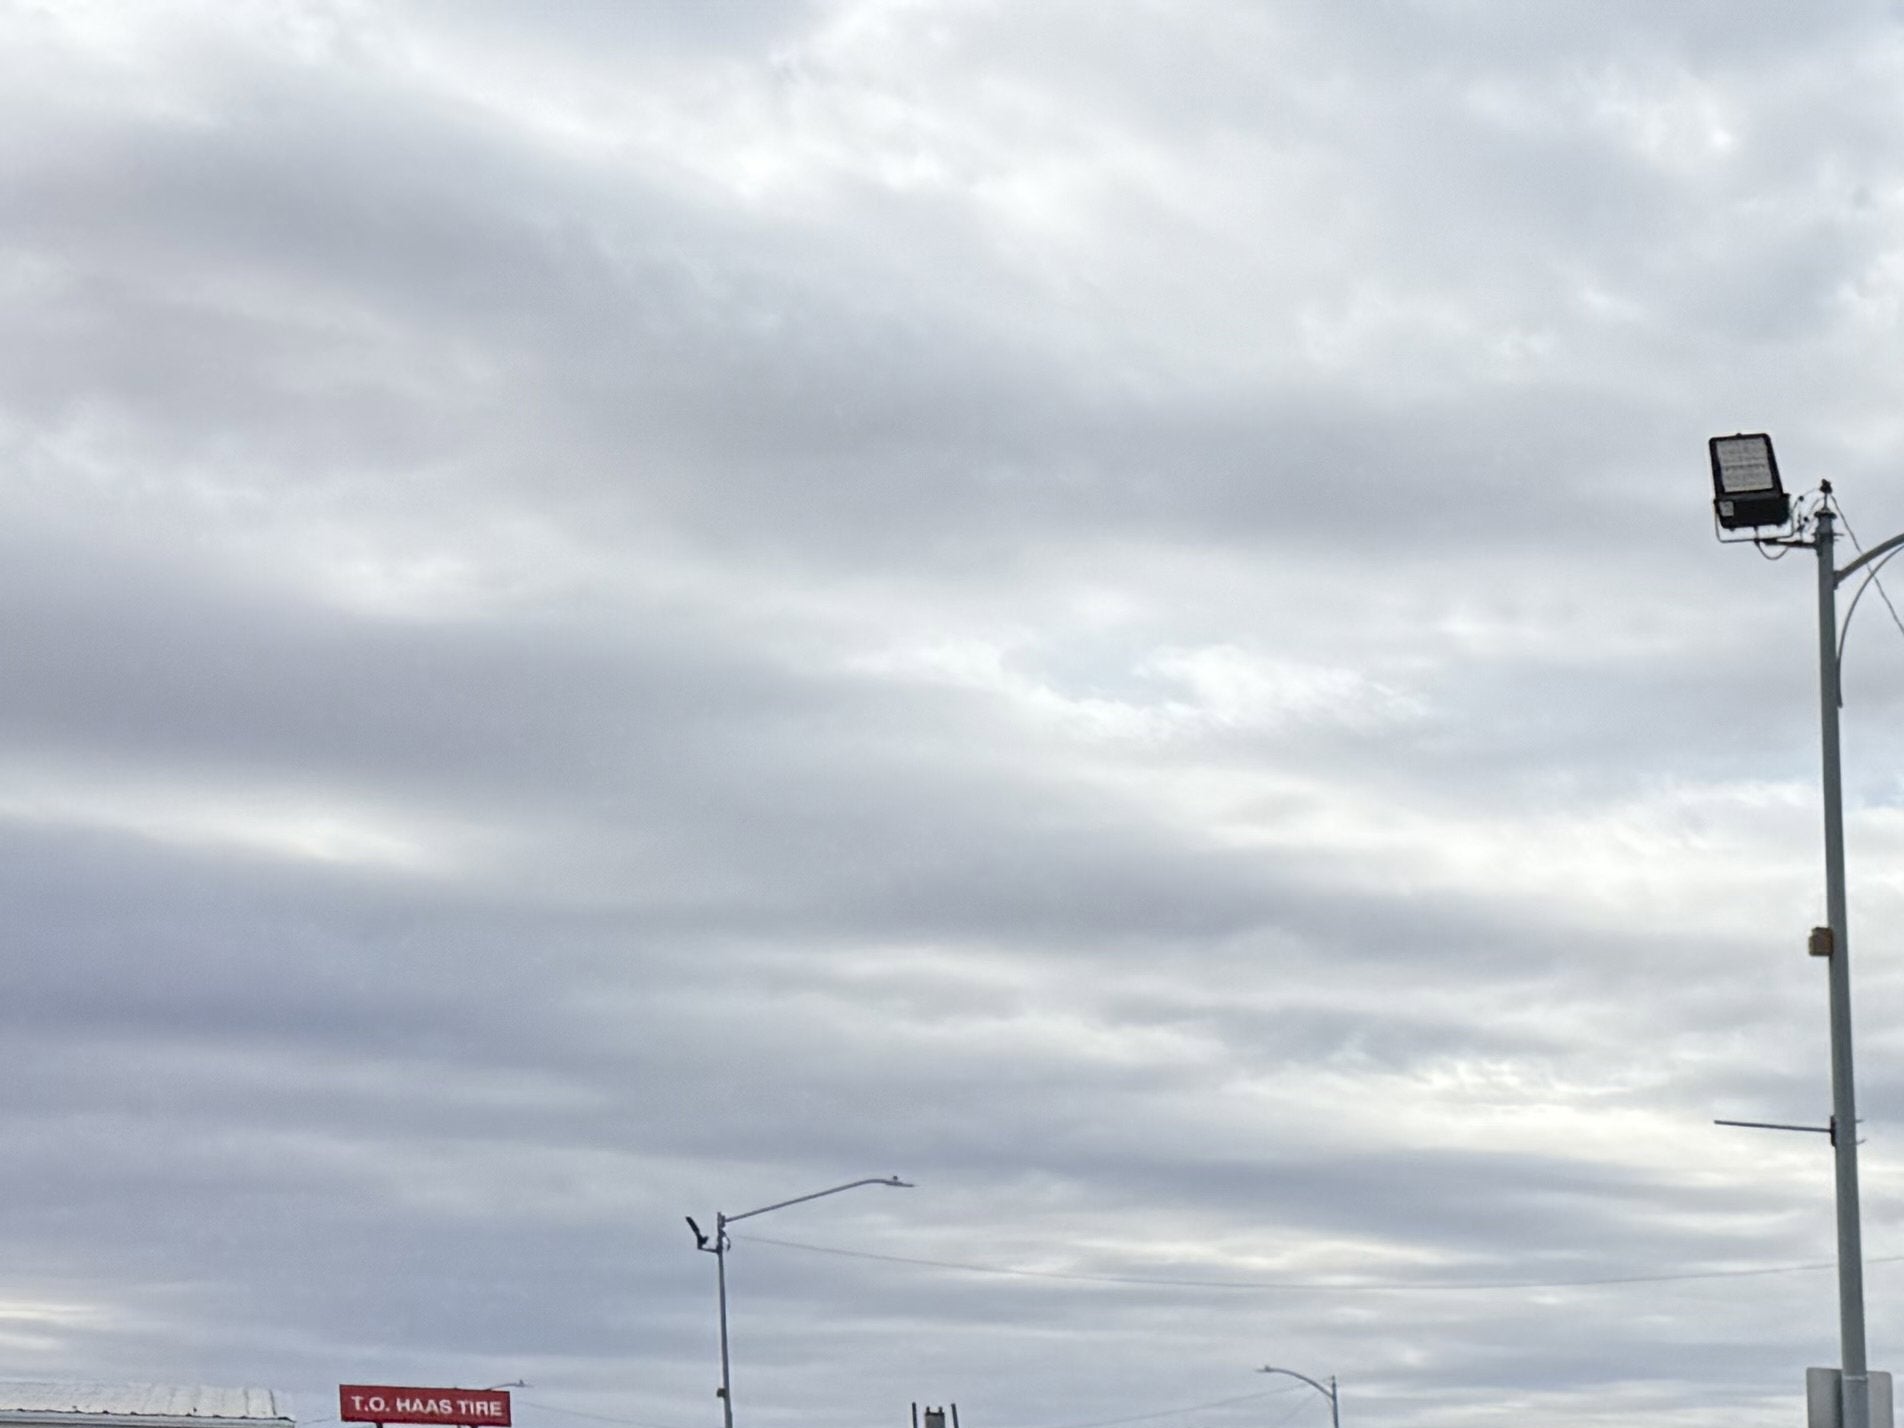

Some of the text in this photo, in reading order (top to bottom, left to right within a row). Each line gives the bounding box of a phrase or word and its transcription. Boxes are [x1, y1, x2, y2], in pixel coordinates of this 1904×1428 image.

[351, 1396, 503, 1417] T.O. HAAS TIRE
